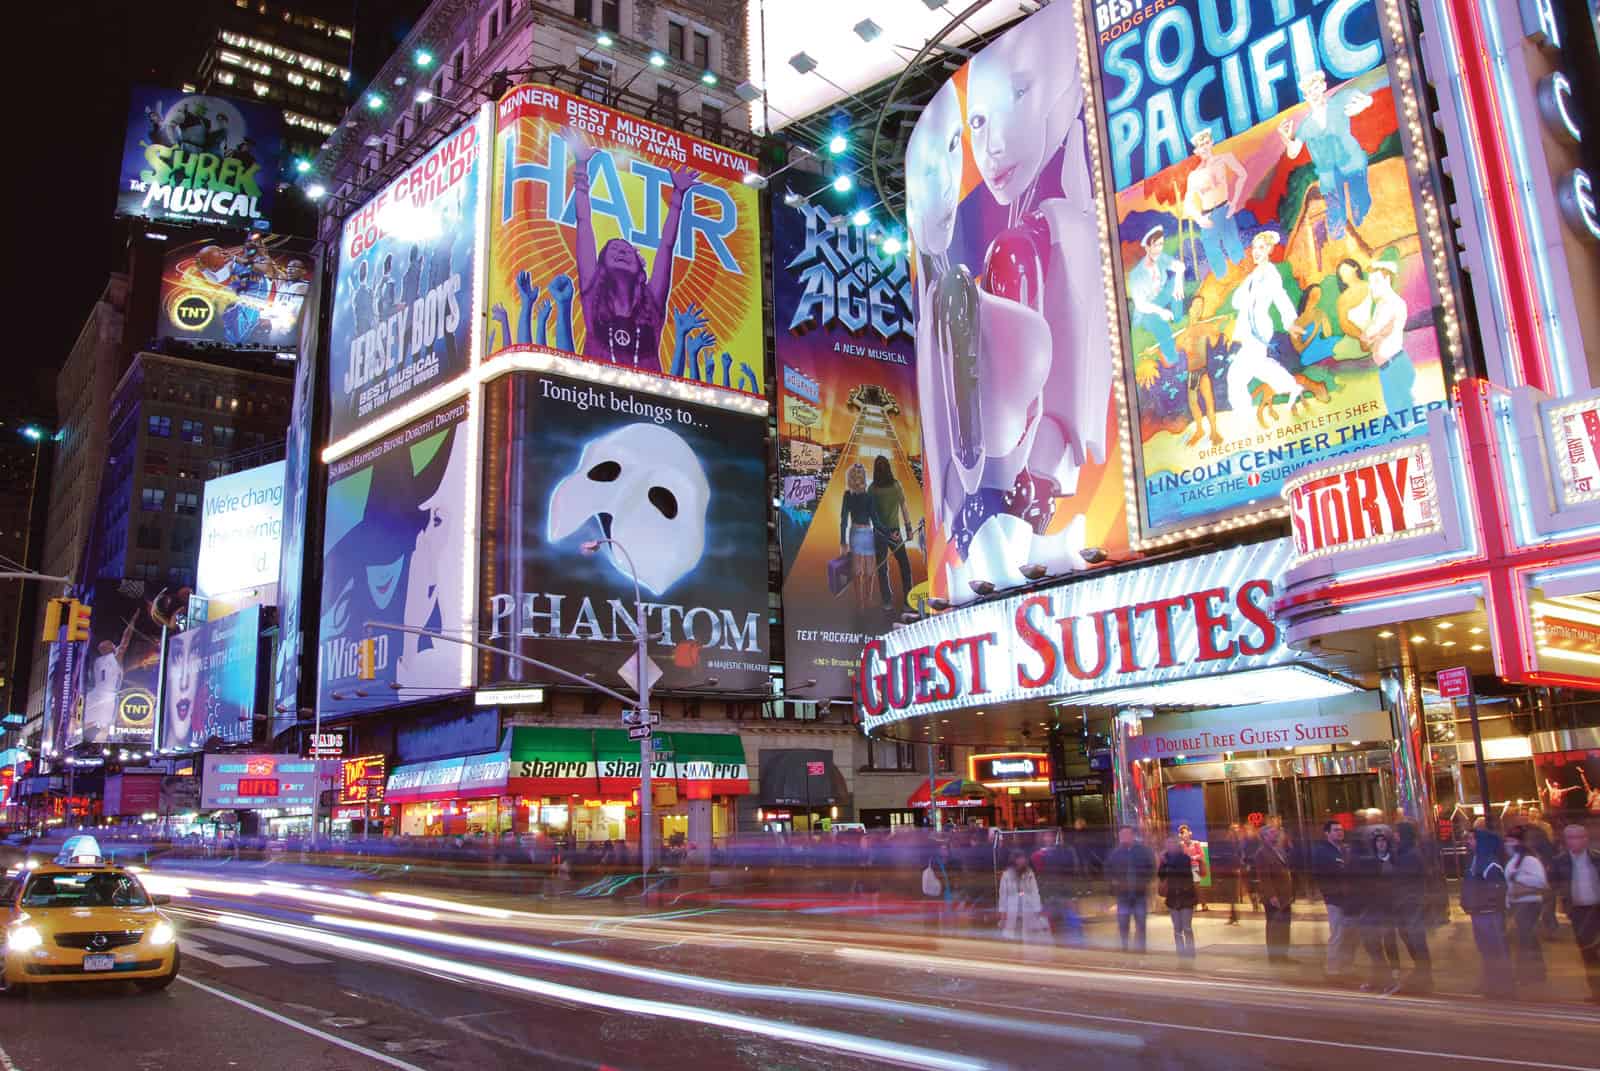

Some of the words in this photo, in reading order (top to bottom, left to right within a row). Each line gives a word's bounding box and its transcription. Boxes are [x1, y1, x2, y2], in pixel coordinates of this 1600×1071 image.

[1103, 0, 1322, 114] SOU
[1107, 0, 1384, 192] PACIFIC
[500, 88, 559, 118] WINNER!
[566, 100, 610, 127] BEST
[616, 117, 687, 153] MUSICAL
[692, 142, 752, 174] REVIVAL
[569, 115, 605, 136] 2009
[610, 129, 642, 149] TONY
[646, 142, 688, 163] AWARD
[140, 140, 262, 198] SHREK
[394, 125, 476, 201] CROWD
[129, 179, 147, 193] THE
[142, 180, 262, 218] MUSICAL
[502, 131, 744, 276] HAIR
[179, 307, 208, 319] TNT
[344, 307, 409, 394] JERSEY
[411, 274, 462, 356] BOYS
[359, 380, 387, 405] BEST
[389, 352, 440, 392] MUSICAL
[413, 364, 440, 389] WINNER
[834, 342, 840, 352] A
[843, 343, 865, 356] NEW
[868, 346, 909, 366] MUSICAL
[538, 378, 606, 410] Tonight
[610, 392, 672, 424] belongs
[1199, 438, 1253, 460] DIRECTED
[1257, 431, 1274, 444] BY
[1276, 411, 1344, 440] BARTLETT
[1345, 400, 1380, 419] SHER
[1149, 459, 1233, 497] LINCOLN
[1240, 432, 1331, 472] CENTER
[1179, 486, 1215, 505] TAKE
[1218, 477, 1246, 494] THE
[1291, 456, 1408, 555] STORY
[488, 592, 762, 653] PHANTOM
[796, 630, 818, 642] TEXT
[860, 632, 998, 717] GUEST
[1015, 578, 1278, 690] SUITES
[125, 704, 149, 715] TNT
[1239, 728, 1290, 745] GUEST
[1295, 723, 1350, 741] SUITES
[241, 780, 276, 795] GIFTS
[520, 757, 587, 778] sbarro
